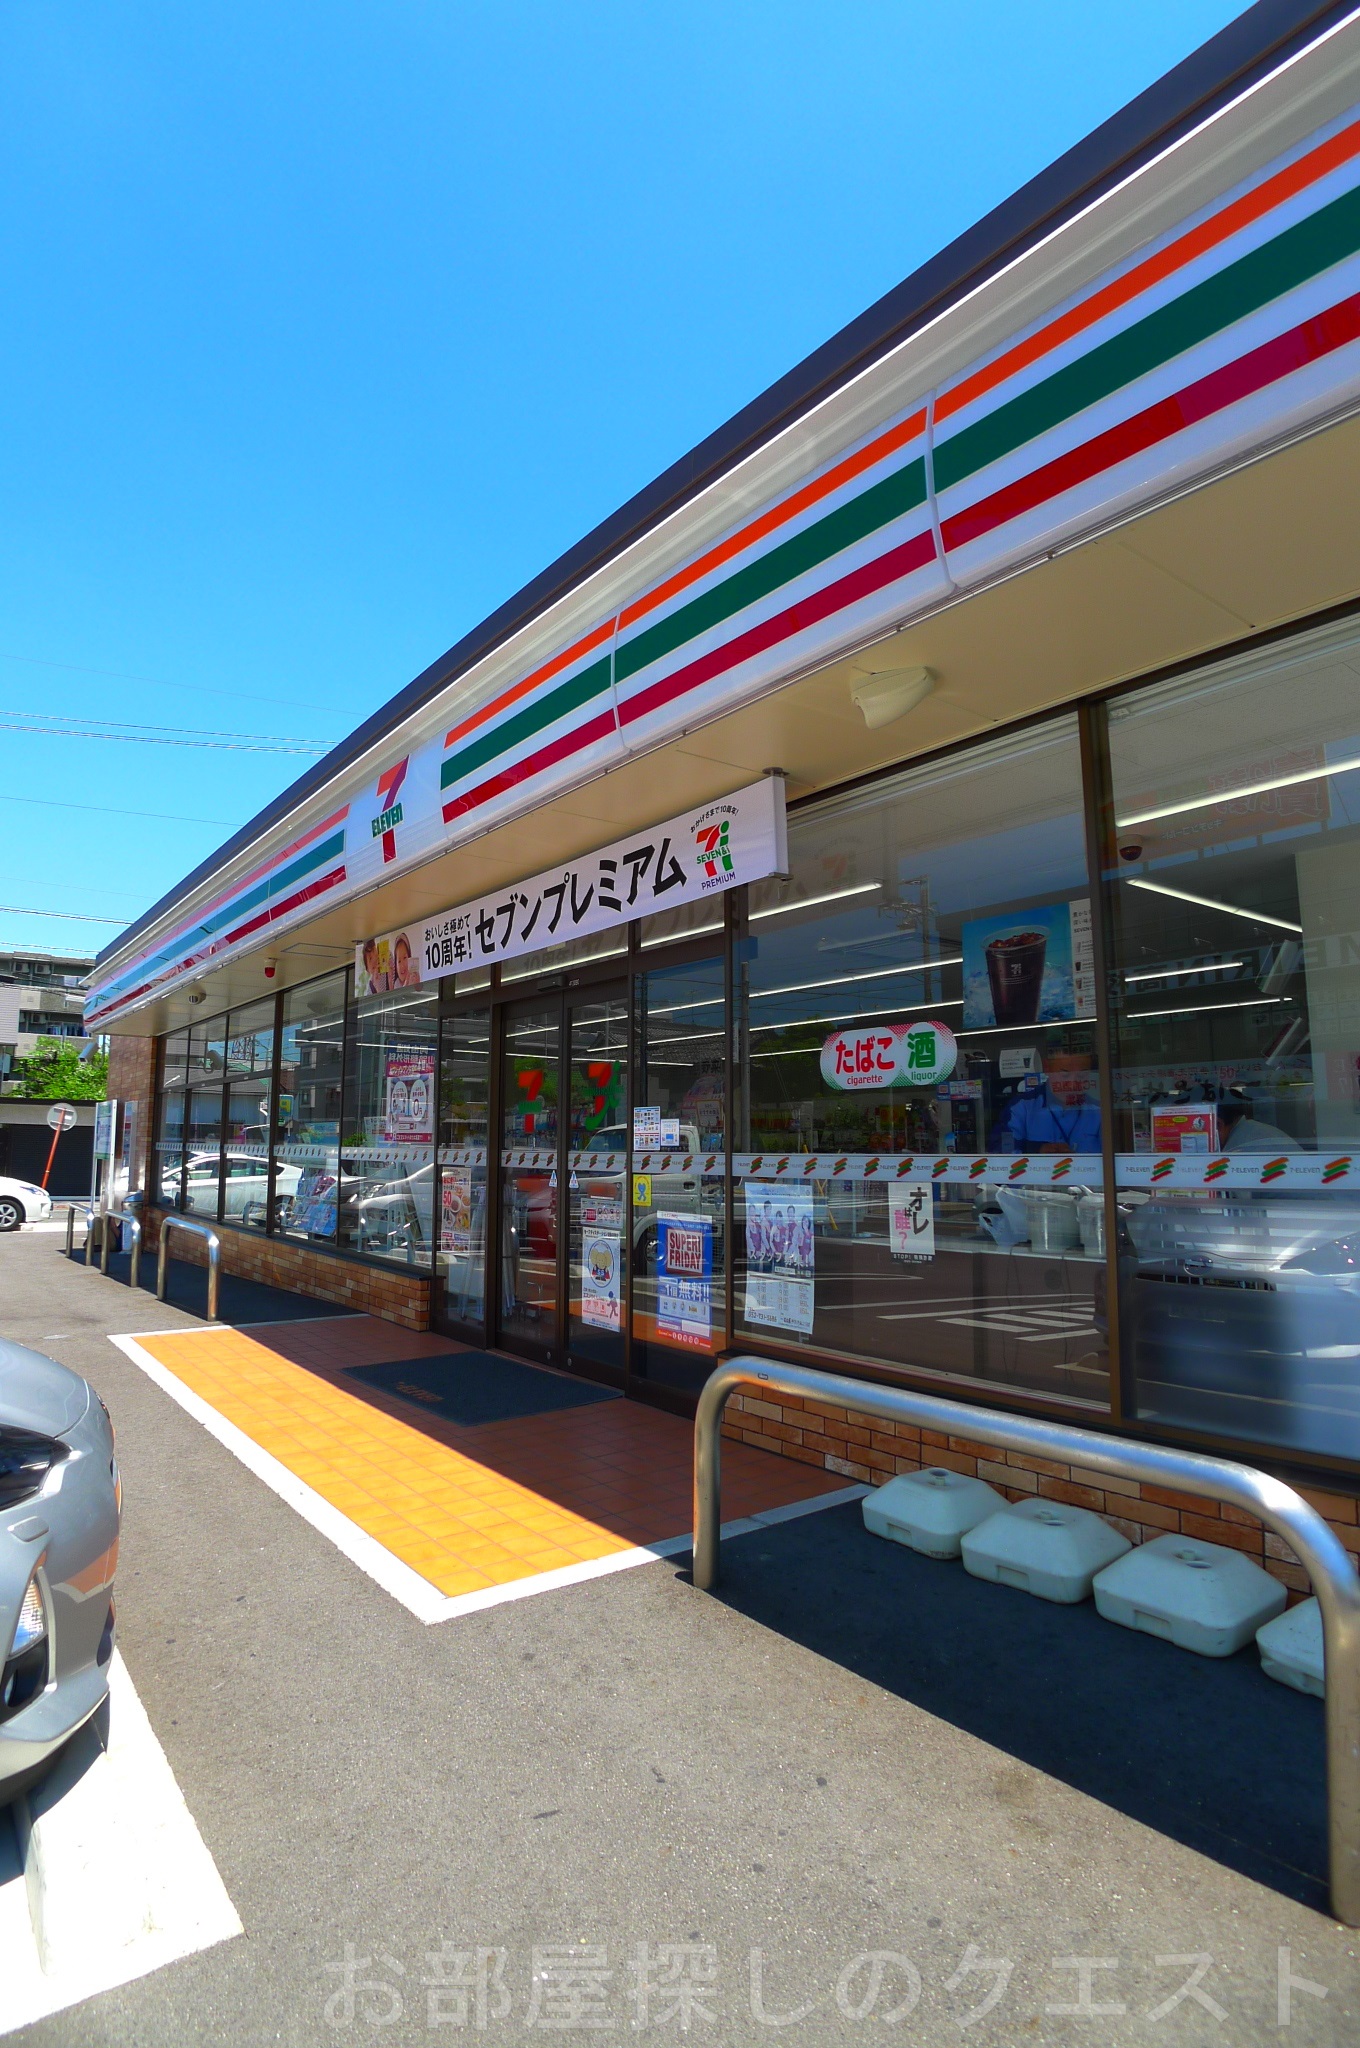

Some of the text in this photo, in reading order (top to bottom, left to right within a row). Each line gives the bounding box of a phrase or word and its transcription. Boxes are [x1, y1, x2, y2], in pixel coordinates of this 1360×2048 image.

[696, 846, 731, 865] SEVEN&i
[701, 871, 736, 891] PREMIUM
[474, 837, 688, 953] セブンプレミアム
[425, 913, 471, 941] おいしさ極めて
[425, 931, 472, 970] 10周年!
[835, 1031, 936, 1075] たばこ 酒
[847, 1071, 938, 1087] cigarette liquor
[669, 1249, 702, 1270] FRIDAY
